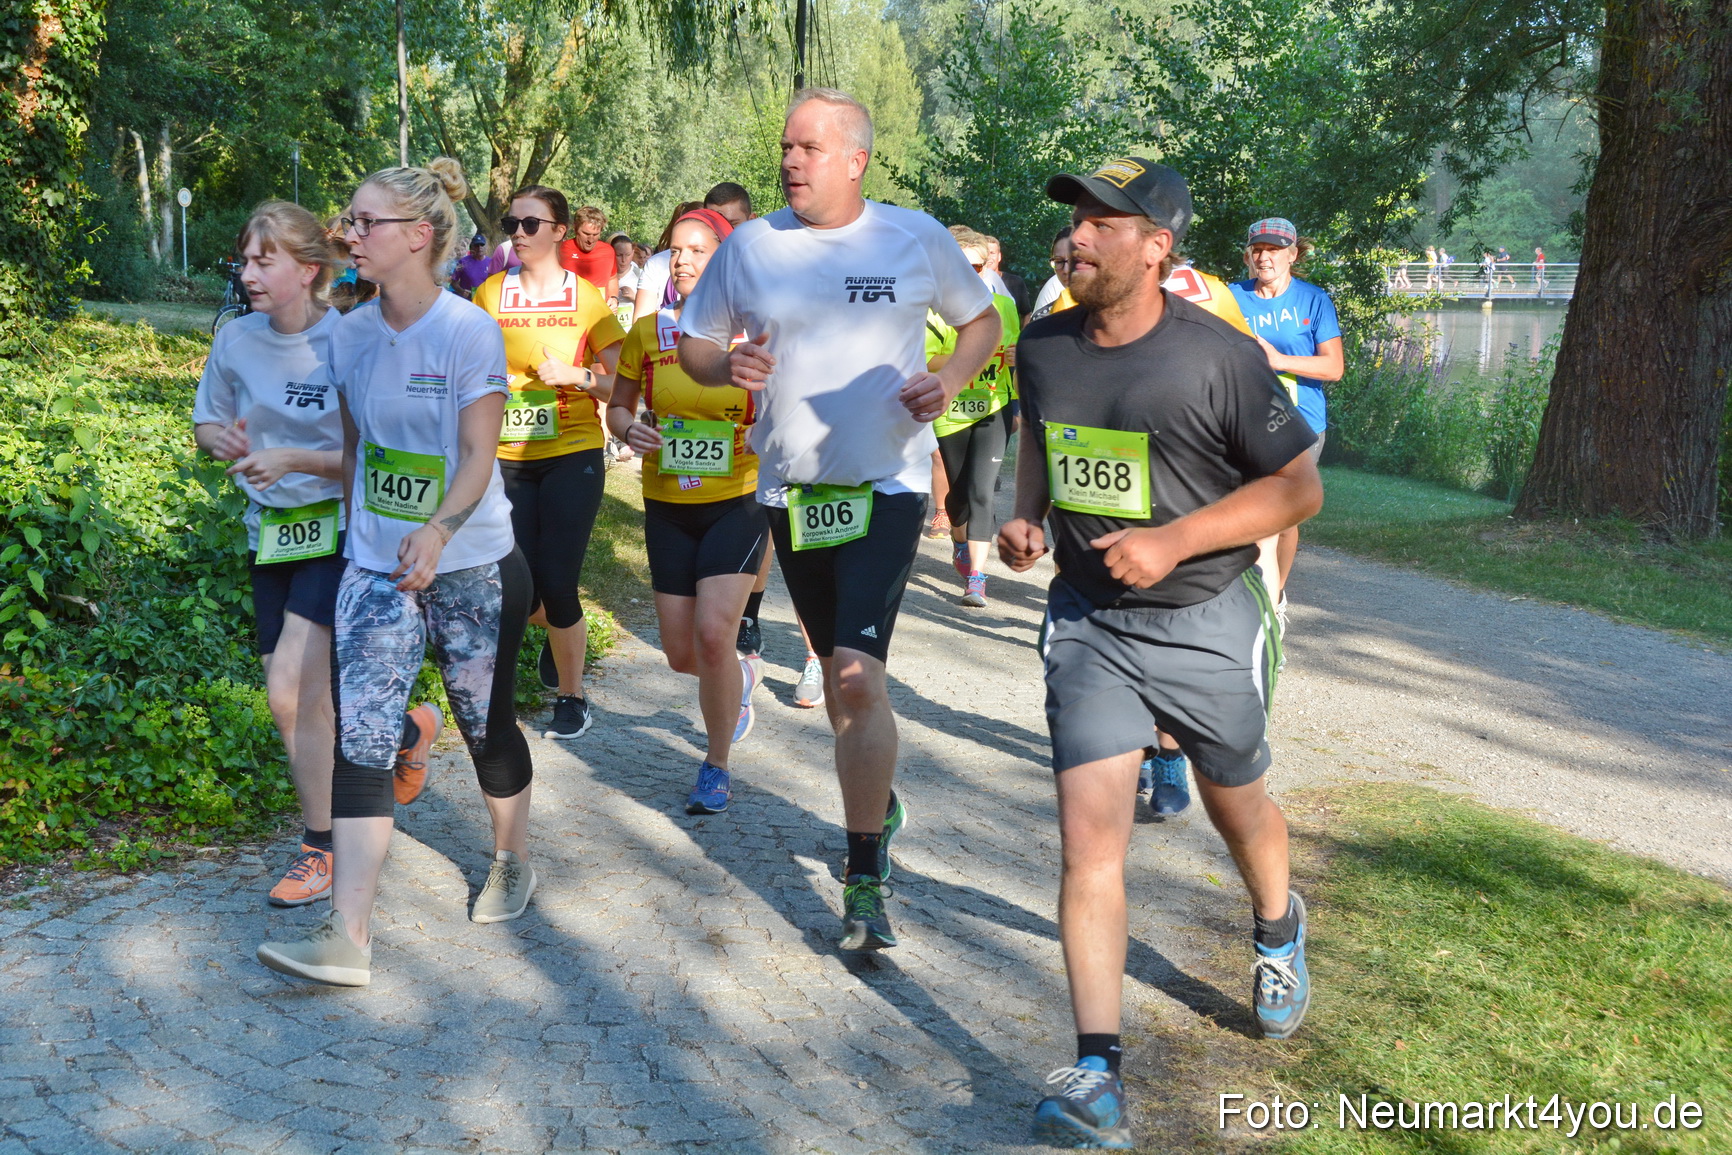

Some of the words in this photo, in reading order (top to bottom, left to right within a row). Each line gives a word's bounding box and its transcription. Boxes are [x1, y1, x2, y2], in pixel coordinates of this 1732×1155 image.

[845, 277, 897, 285] RUNNING
[845, 286, 897, 303] TGA
[498, 318, 531, 328] MAX
[537, 315, 577, 327] BÖGL
[285, 381, 329, 392] RUNNING
[285, 390, 325, 410] TGA
[952, 401, 985, 412] 2136
[504, 408, 548, 426] 1326
[668, 438, 724, 460] 1325
[1058, 456, 1131, 492] 1368
[370, 470, 431, 503] 1407
[1069, 487, 1087, 496] Klein
[1089, 491, 1120, 500] Michael
[378, 497, 393, 506] Meier
[394, 500, 418, 510] Nadine
[806, 501, 854, 529] 806
[277, 520, 321, 547] 808
[802, 528, 833, 538] Korpowski
[835, 524, 860, 533] Andreas
